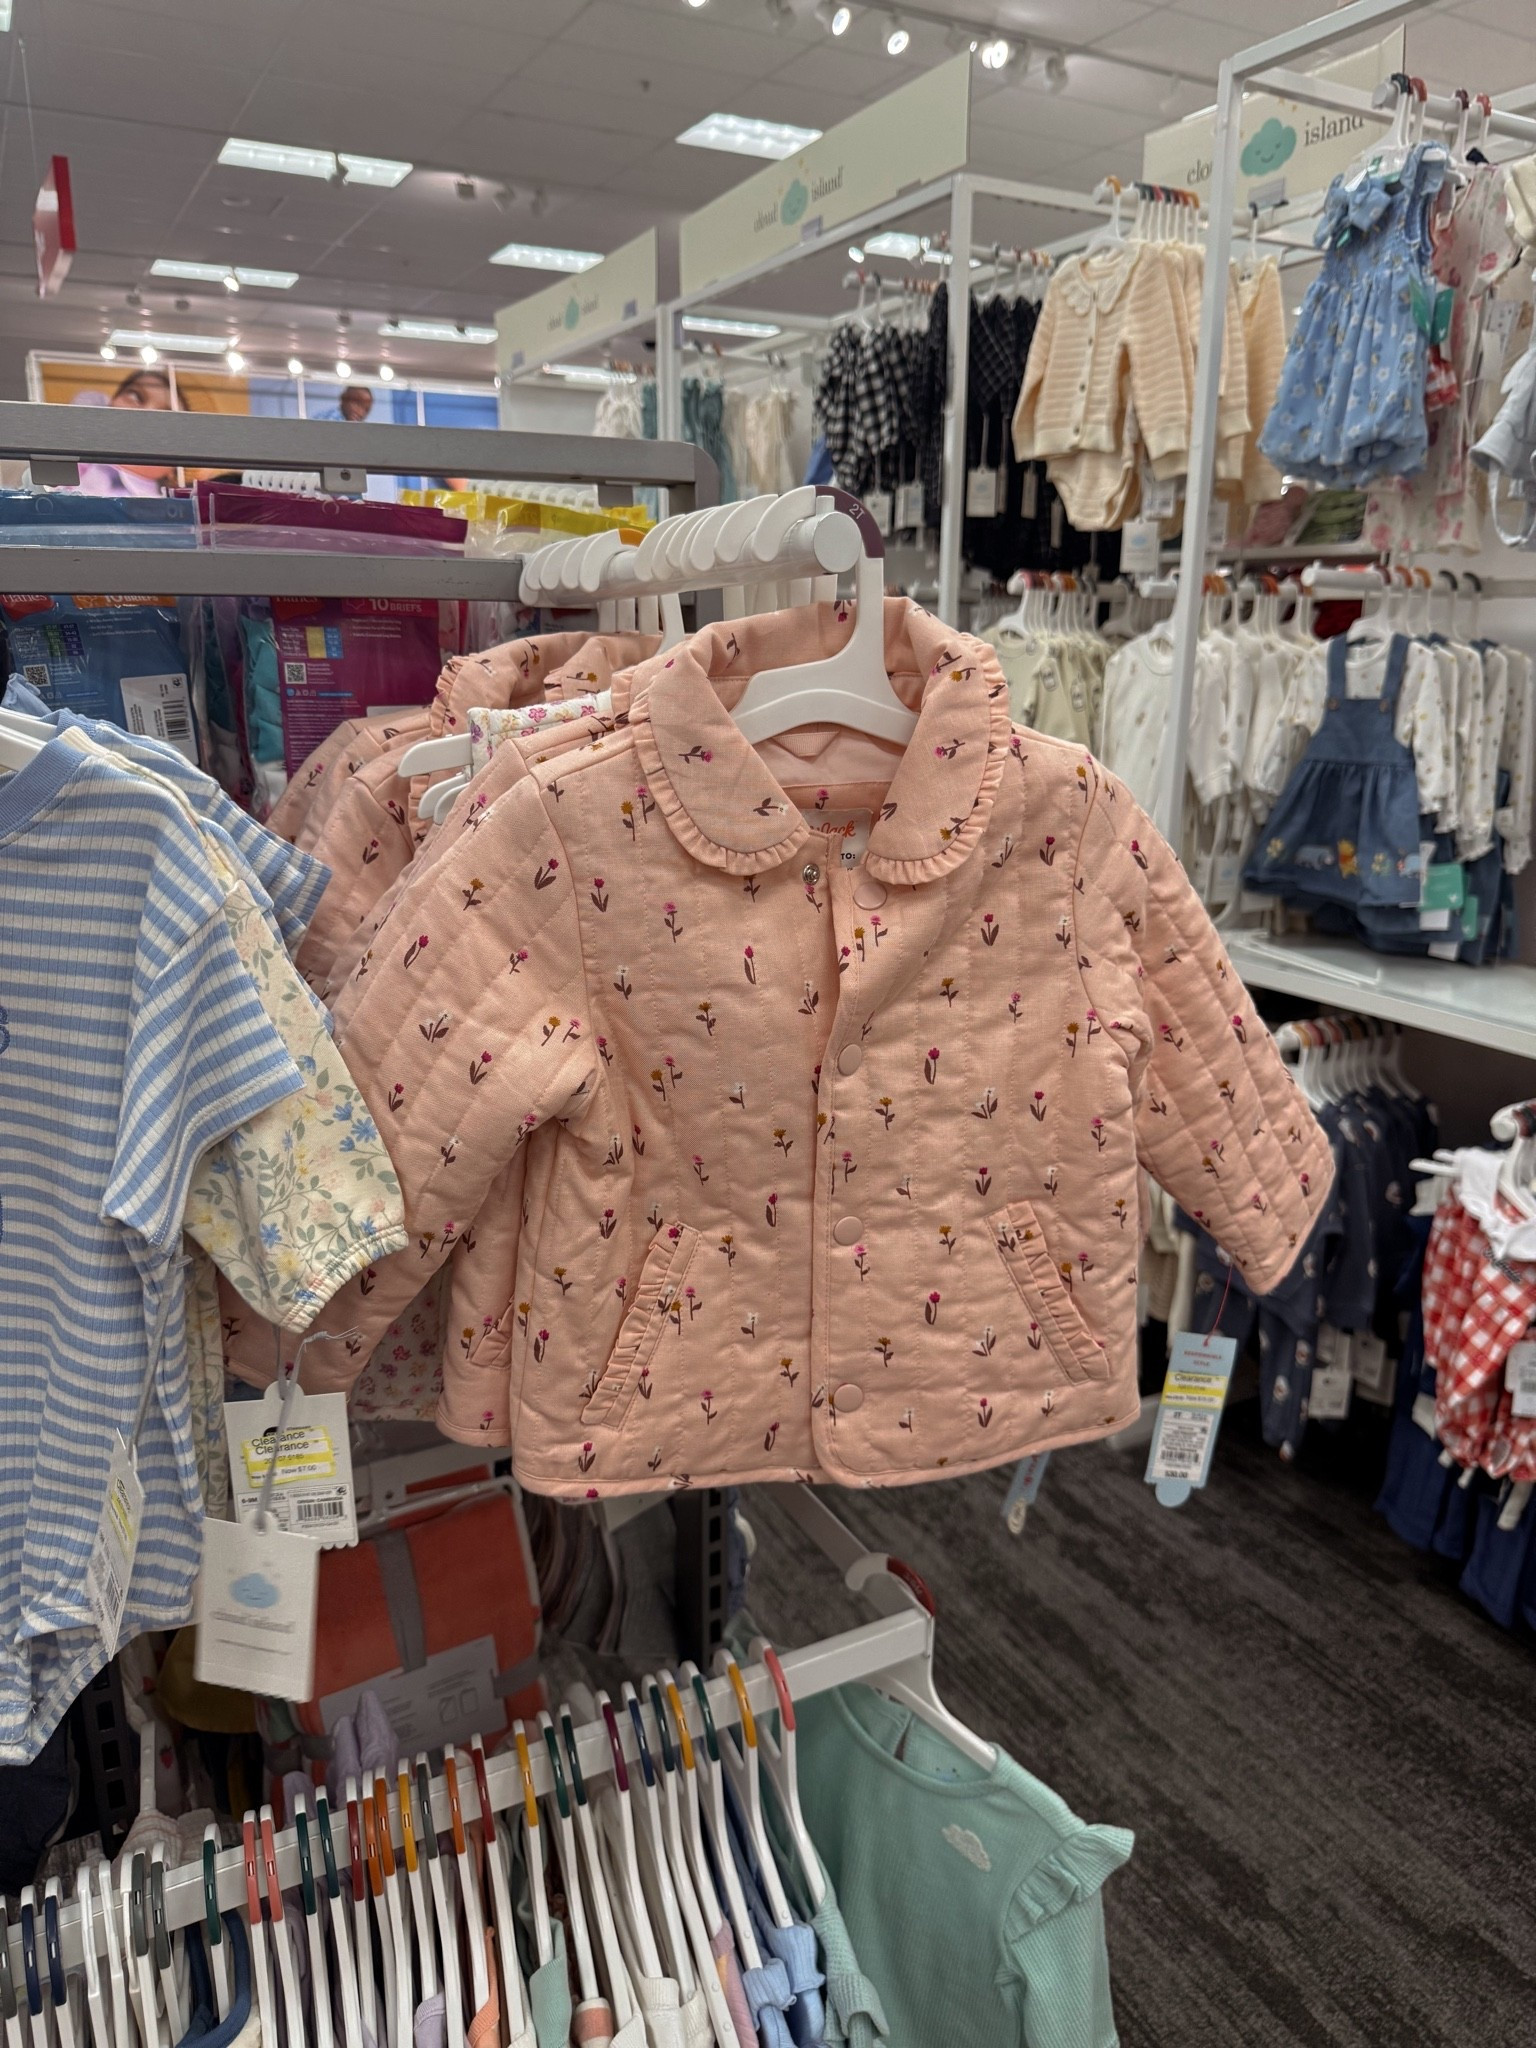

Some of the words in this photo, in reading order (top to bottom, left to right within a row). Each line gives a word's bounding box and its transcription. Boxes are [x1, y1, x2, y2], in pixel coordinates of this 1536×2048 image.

[1304, 115, 1365, 147] island
[811, 164, 845, 202] island
[848, 503, 865, 520] 2T
[368, 598, 390, 611] 10
[390, 602, 423, 613] BRIEFS
[251, 1430, 305, 1448] Cleaance
